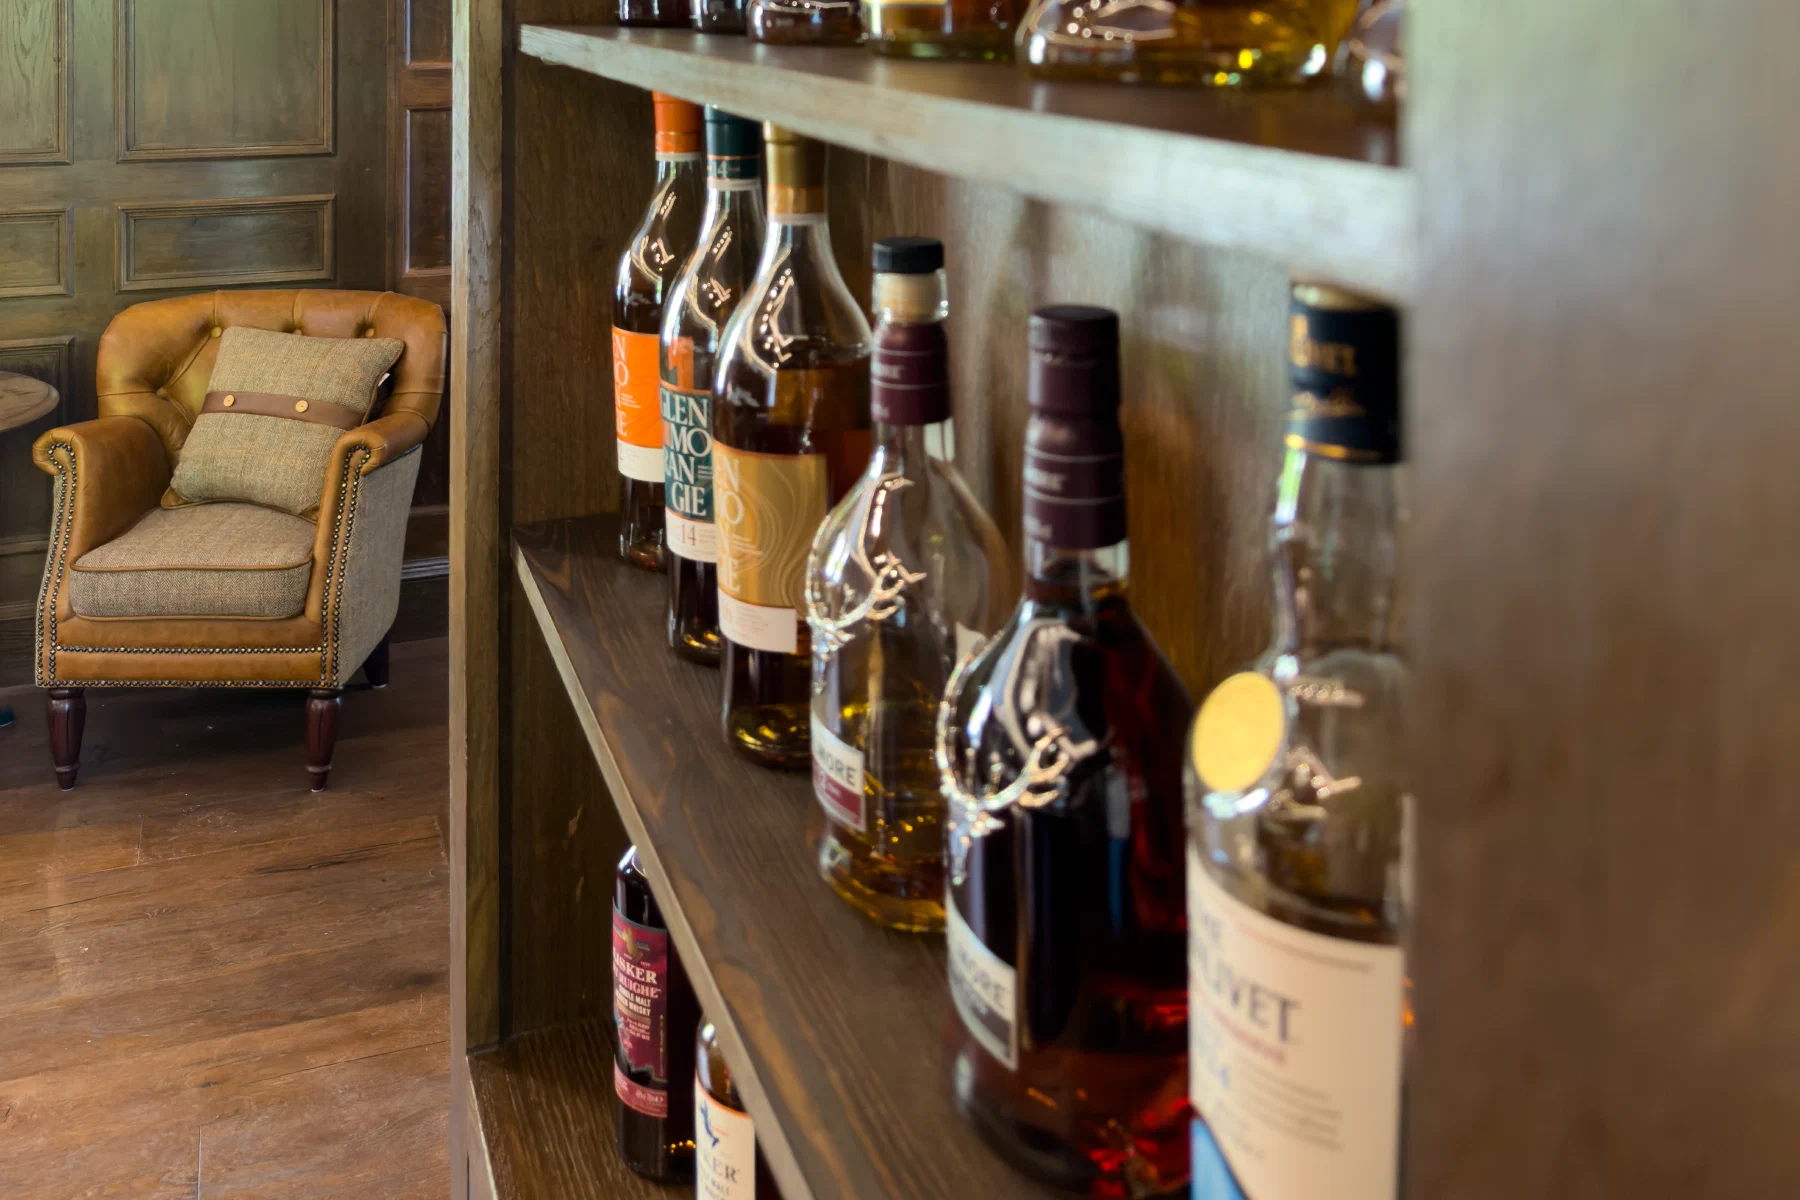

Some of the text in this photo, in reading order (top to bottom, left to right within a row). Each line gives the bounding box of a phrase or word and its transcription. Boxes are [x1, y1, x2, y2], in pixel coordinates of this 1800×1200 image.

[669, 422, 713, 458] MO
[670, 481, 707, 517] GIE
[680, 523, 697, 547] 14
[628, 1001, 652, 1017] WHISKY
